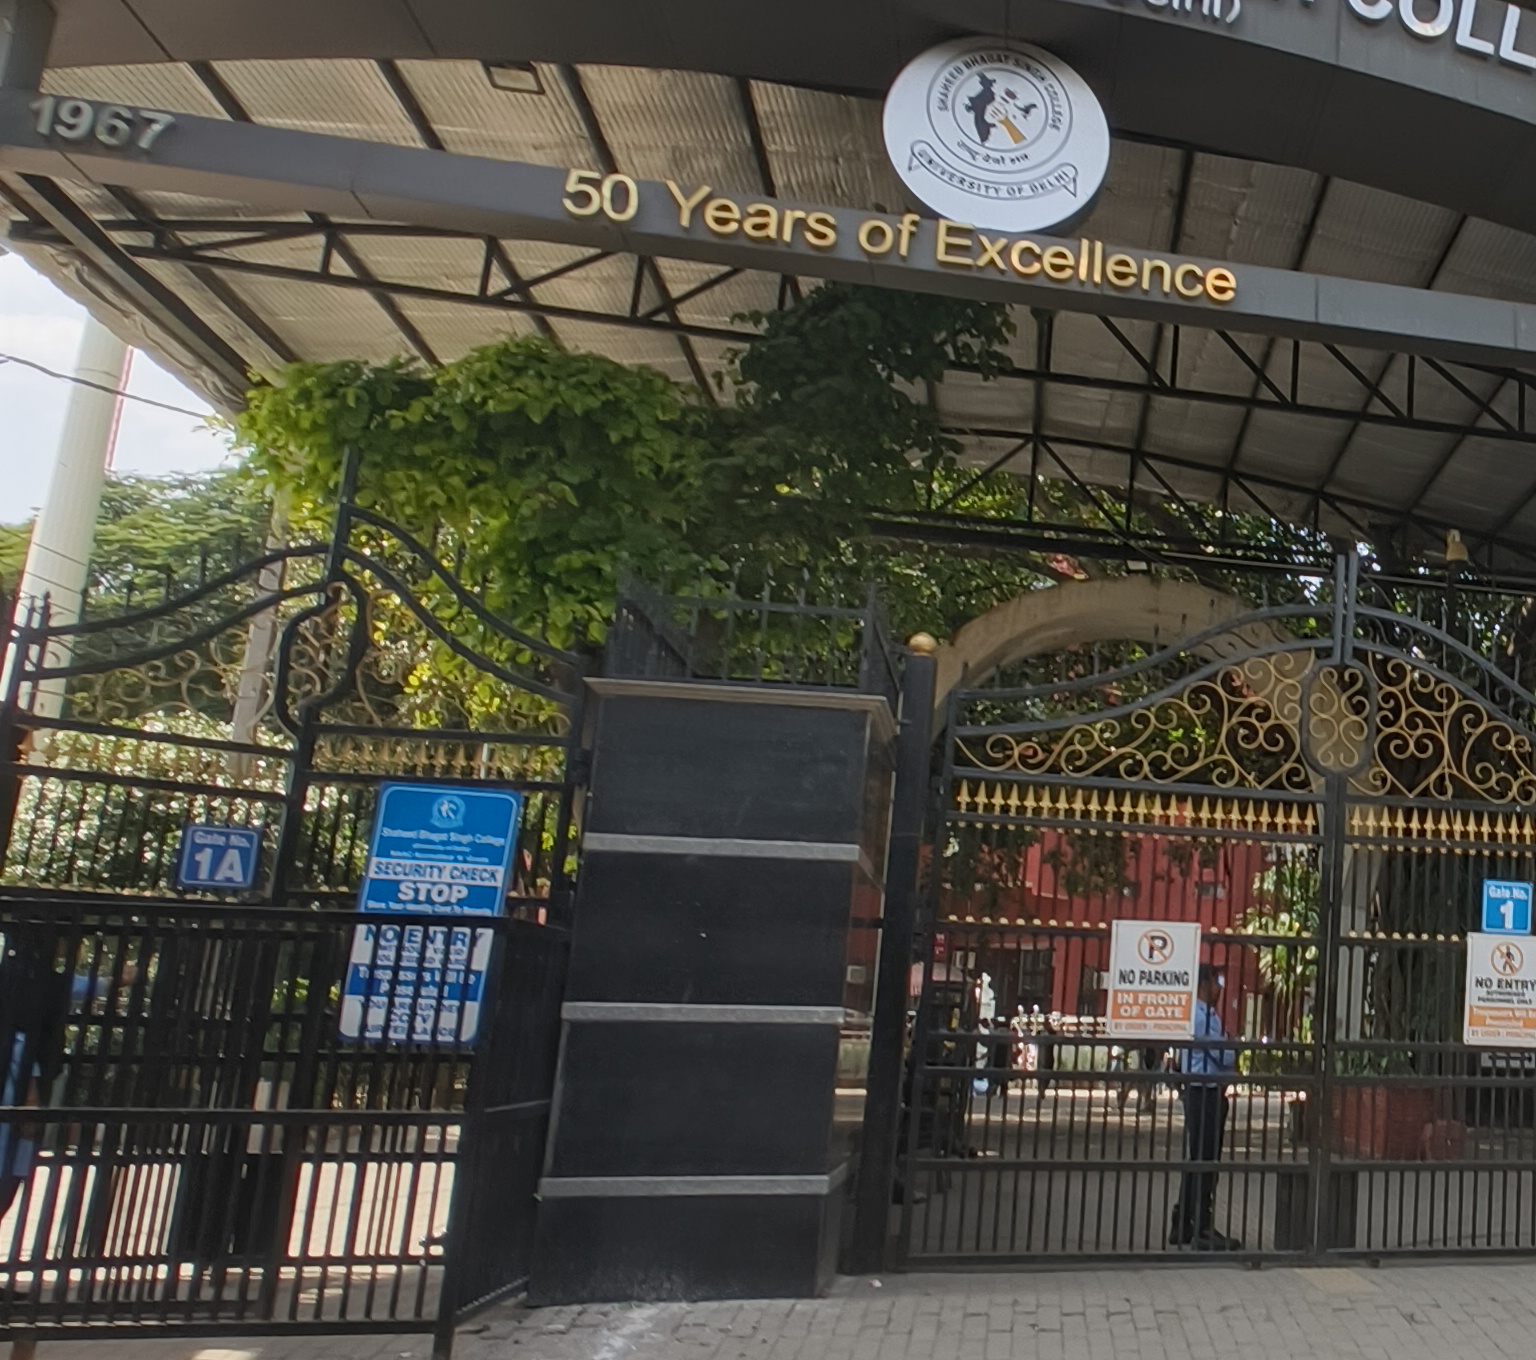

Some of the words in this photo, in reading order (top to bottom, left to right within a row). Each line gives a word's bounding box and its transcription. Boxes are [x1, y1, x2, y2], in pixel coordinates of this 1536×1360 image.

[29, 96, 176, 150] 1967
[562, 168, 639, 222] 50
[666, 180, 837, 247] Years
[858, 214, 921, 257] of
[936, 218, 1237, 302] Excellence
[194, 847, 244, 882] 1A
[374, 860, 446, 880] SECURITY
[450, 865, 499, 883] CHECK
[397, 881, 469, 904] STOP
[1500, 900, 1514, 930] 1
[1118, 968, 1136, 985] NO
[1139, 970, 1190, 987] PARKING
[1475, 976, 1493, 989] NO
[1117, 992, 1133, 1004] IN
[1138, 993, 1188, 1006] FRONT
[1120, 1005, 1141, 1017] OF
[1144, 1006, 1184, 1019] GATE
